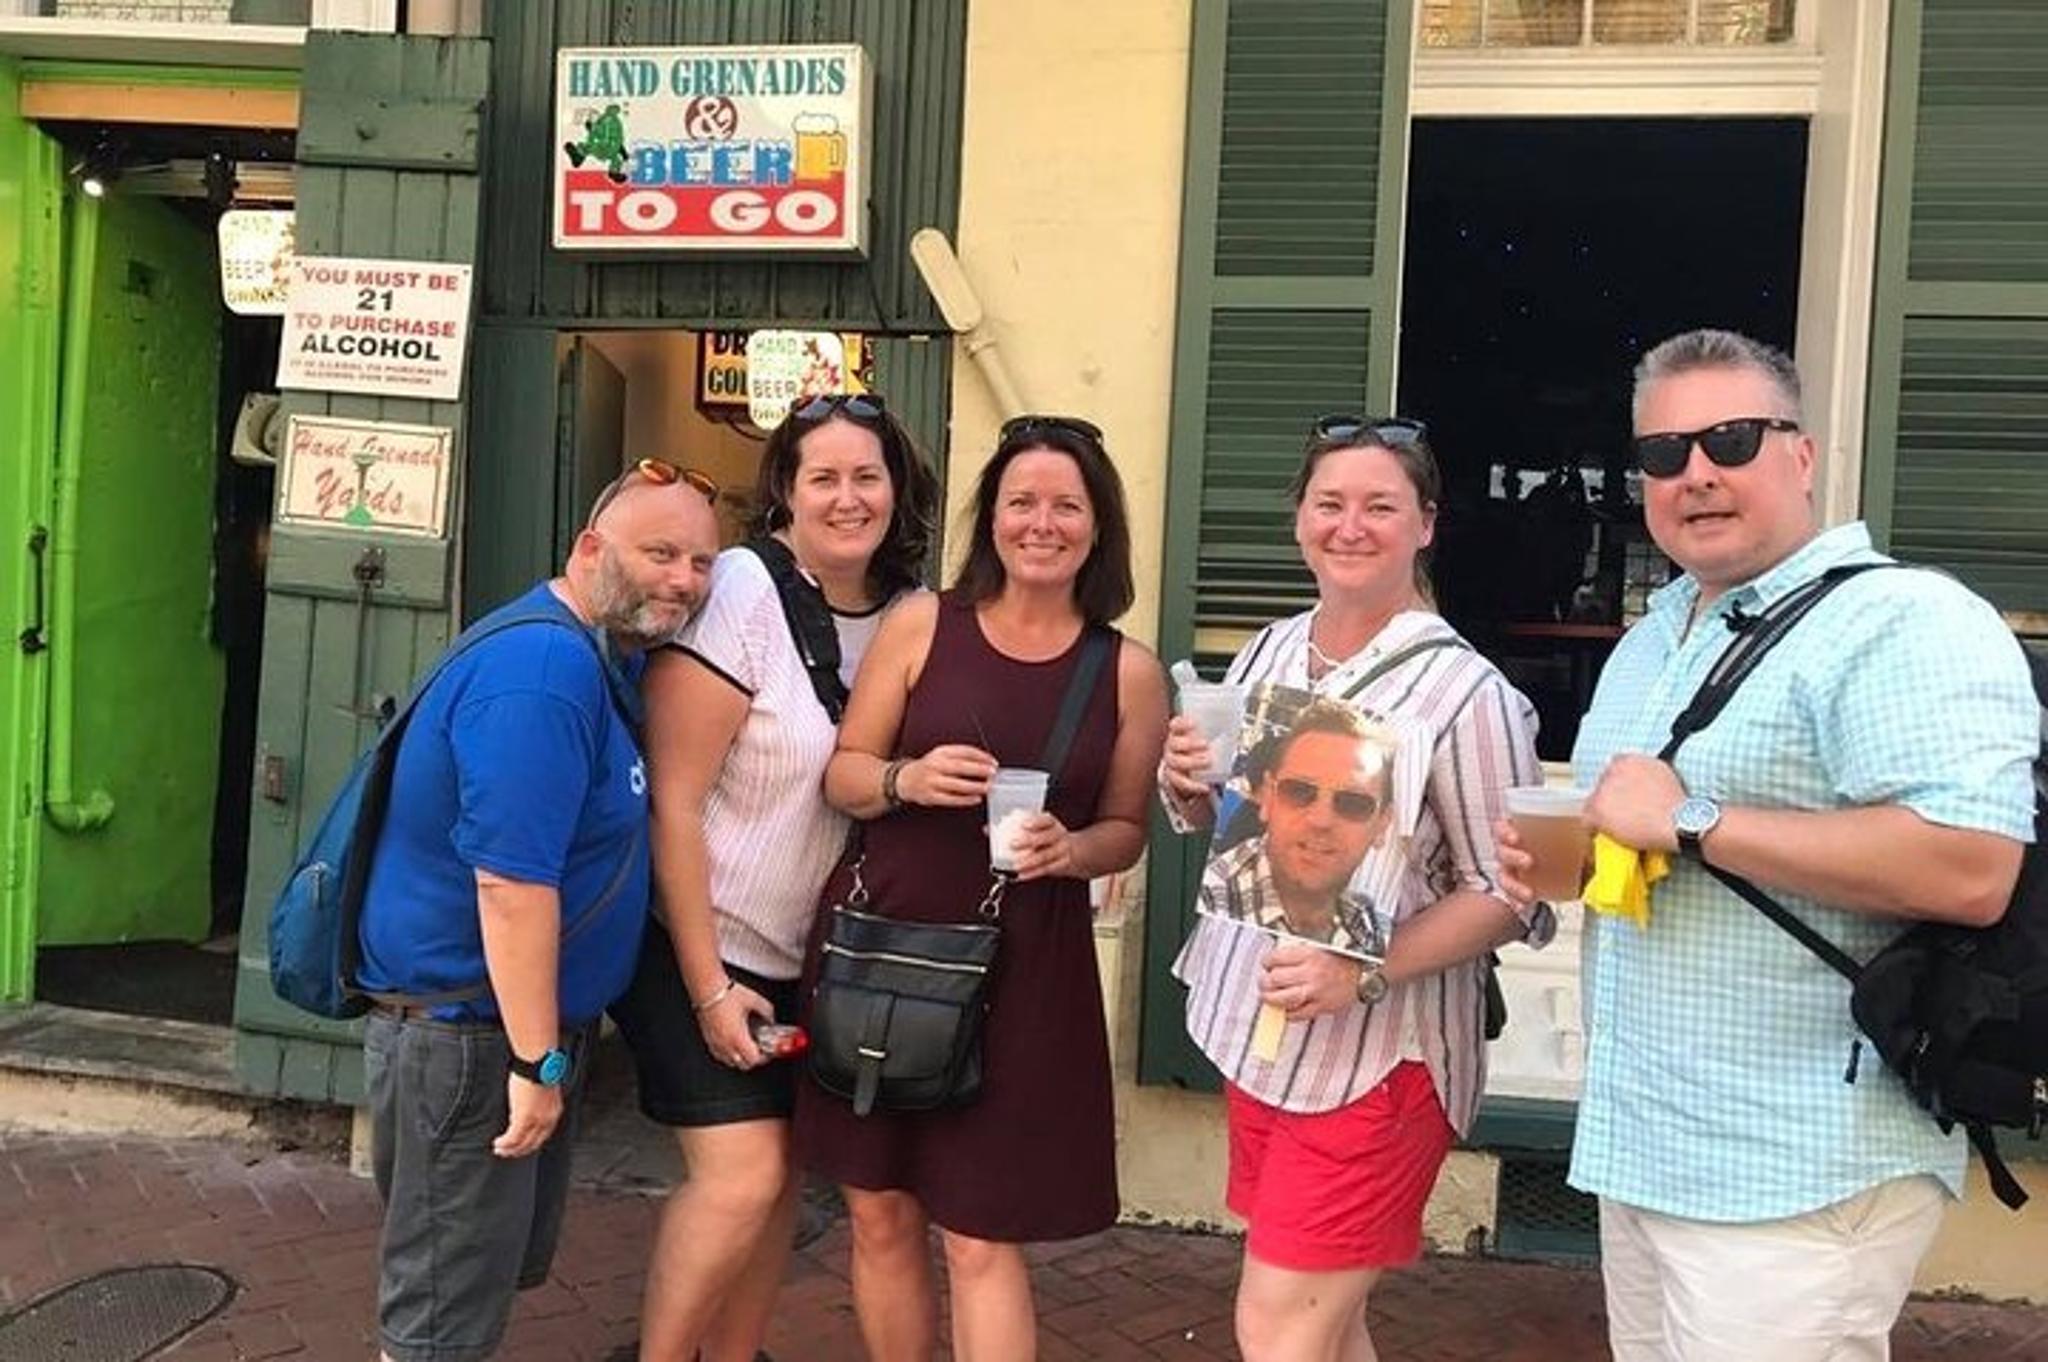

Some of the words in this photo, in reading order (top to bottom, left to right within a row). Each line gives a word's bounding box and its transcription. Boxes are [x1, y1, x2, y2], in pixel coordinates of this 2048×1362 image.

[569, 60, 660, 97] HAND
[670, 58, 846, 96] GRENADES
[687, 96, 736, 140] &
[629, 141, 792, 186] BEER
[569, 190, 677, 232] TO
[709, 190, 838, 233] GO
[302, 266, 349, 285] YOU
[354, 269, 422, 288] MUST
[428, 274, 459, 291] BE
[356, 289, 394, 311] 21
[294, 313, 323, 330] TO
[329, 315, 456, 338] PURCHASE
[300, 333, 441, 361] ALCOHOL
